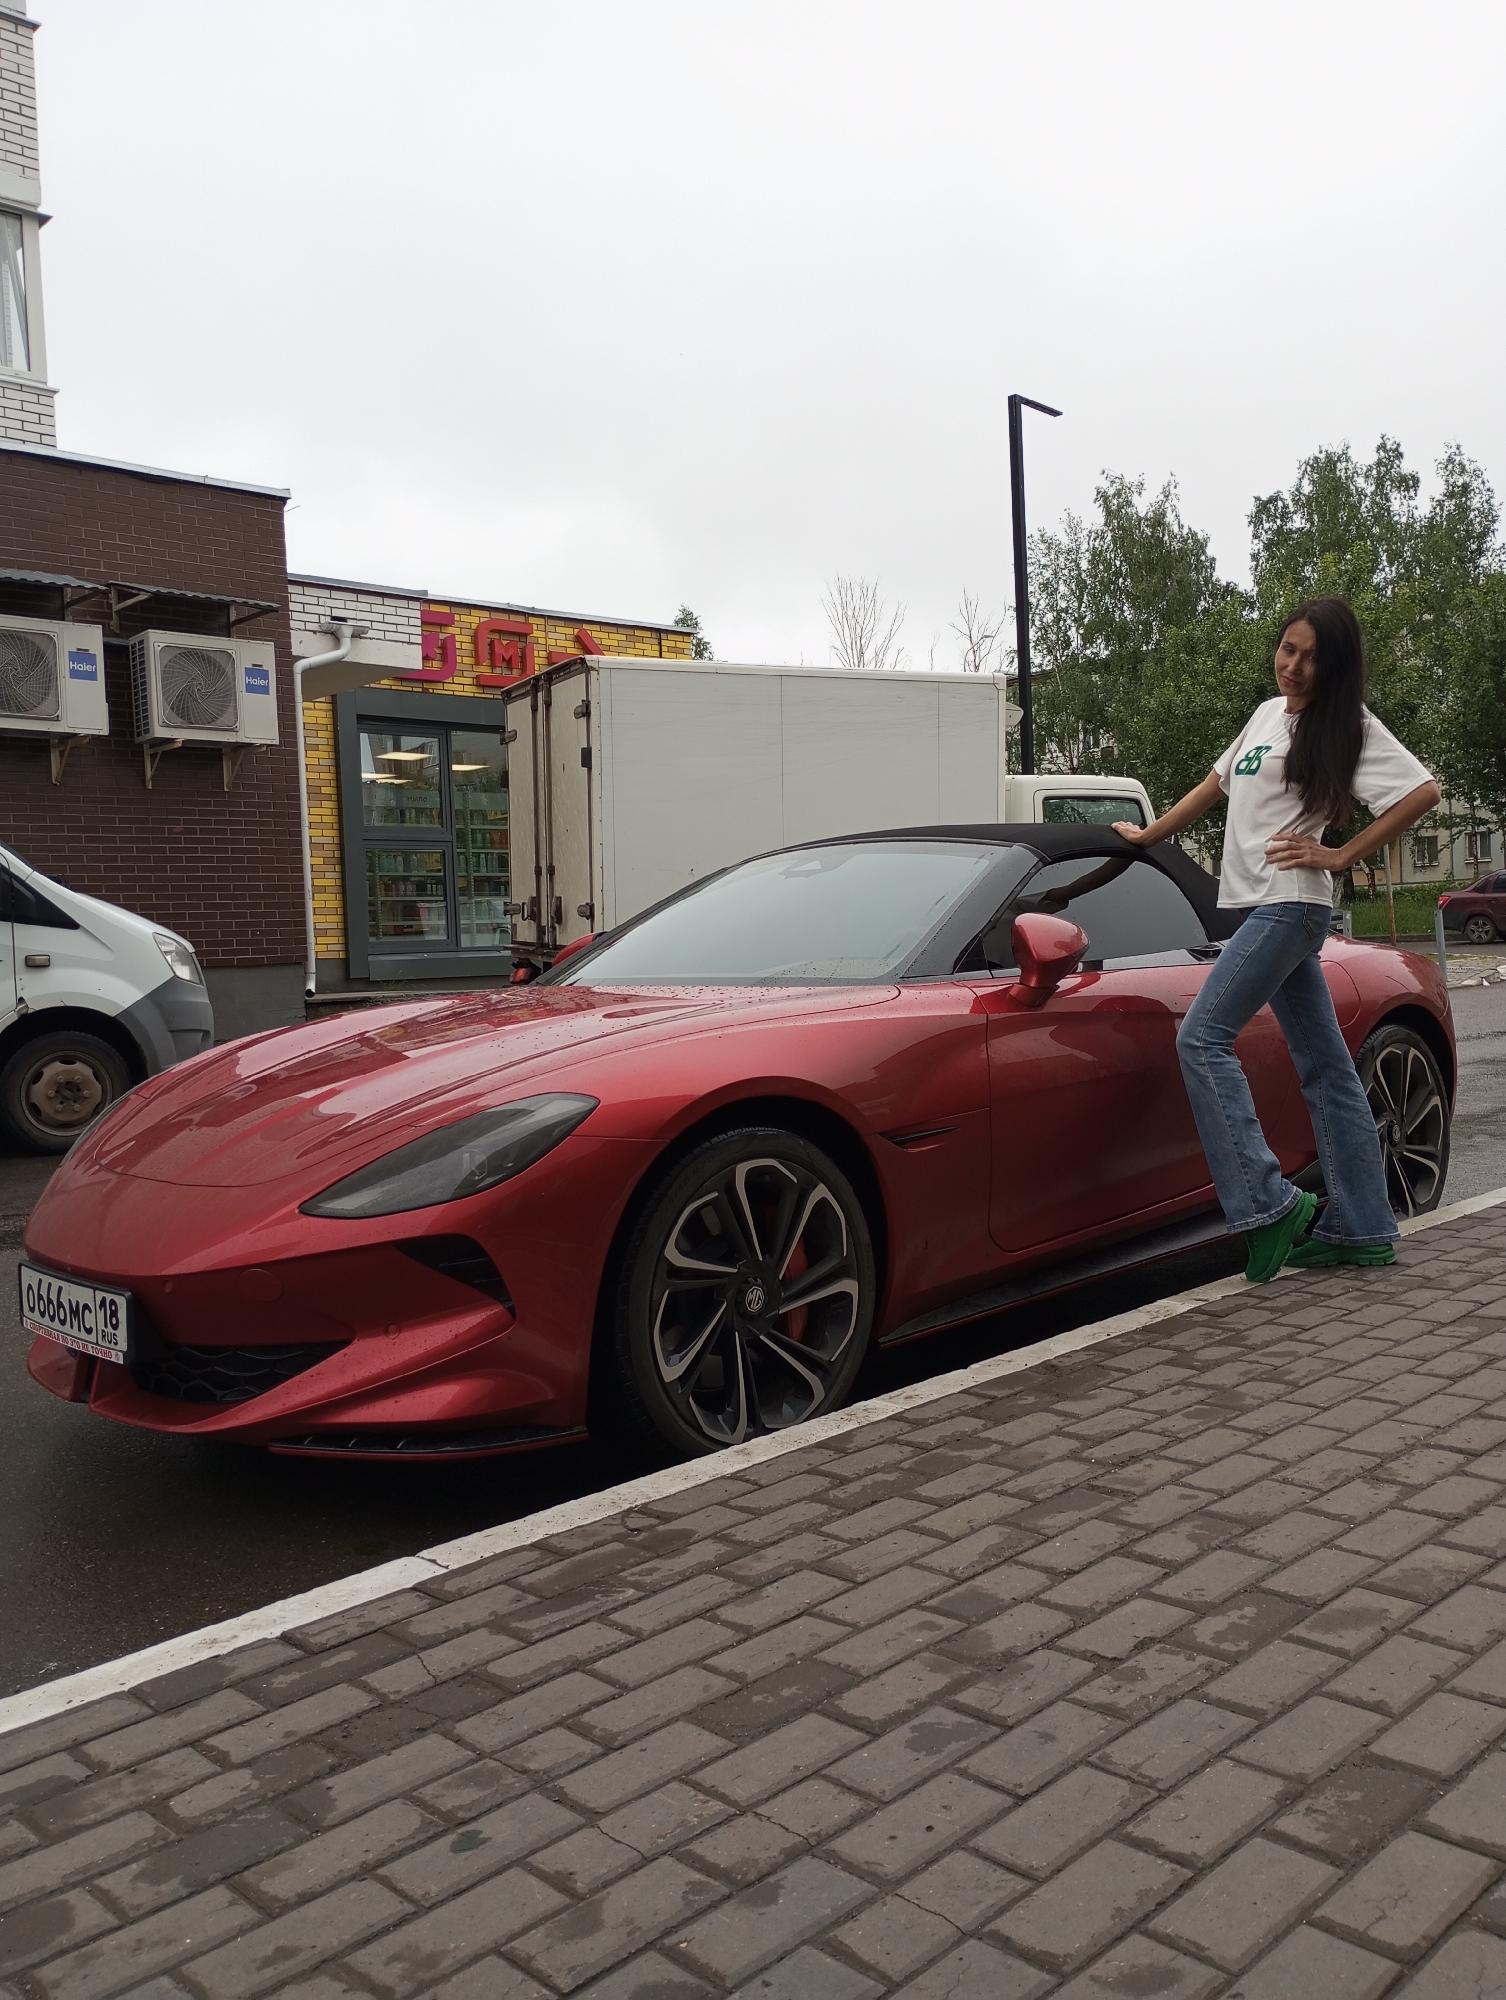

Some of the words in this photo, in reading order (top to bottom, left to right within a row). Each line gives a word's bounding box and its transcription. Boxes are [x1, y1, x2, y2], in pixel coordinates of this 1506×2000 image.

[69, 660, 98, 673] Haier
[245, 675, 270, 688] Haier
[98, 1295, 120, 1332] 18
[101, 1328, 119, 1347] RUS
[70, 1336, 81, 1350] ЭТО
[91, 1344, 113, 1360] ТОЧНО
